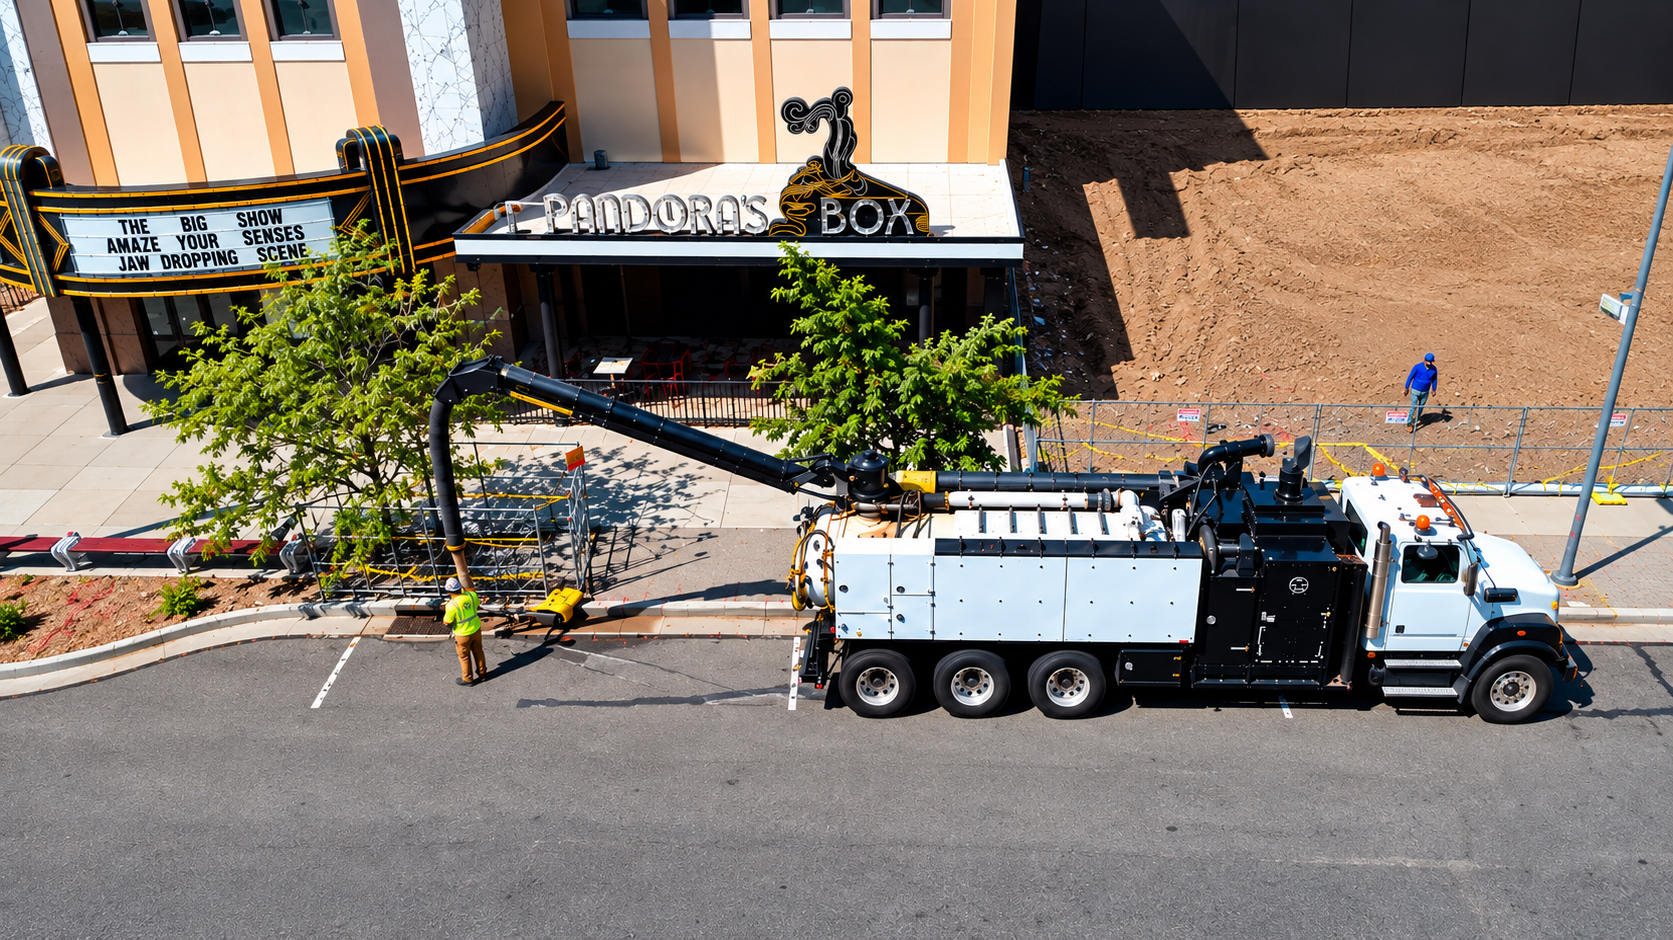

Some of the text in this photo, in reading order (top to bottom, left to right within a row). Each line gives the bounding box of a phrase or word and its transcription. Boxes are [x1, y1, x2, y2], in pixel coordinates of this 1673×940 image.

[118, 208, 283, 235] THE BIG SHOW
[543, 193, 914, 235] PANDORA'S BOX
[107, 225, 305, 254] AMAZE YOUR SENSES
[118, 243, 309, 272] JAW DROPPING SCENE
